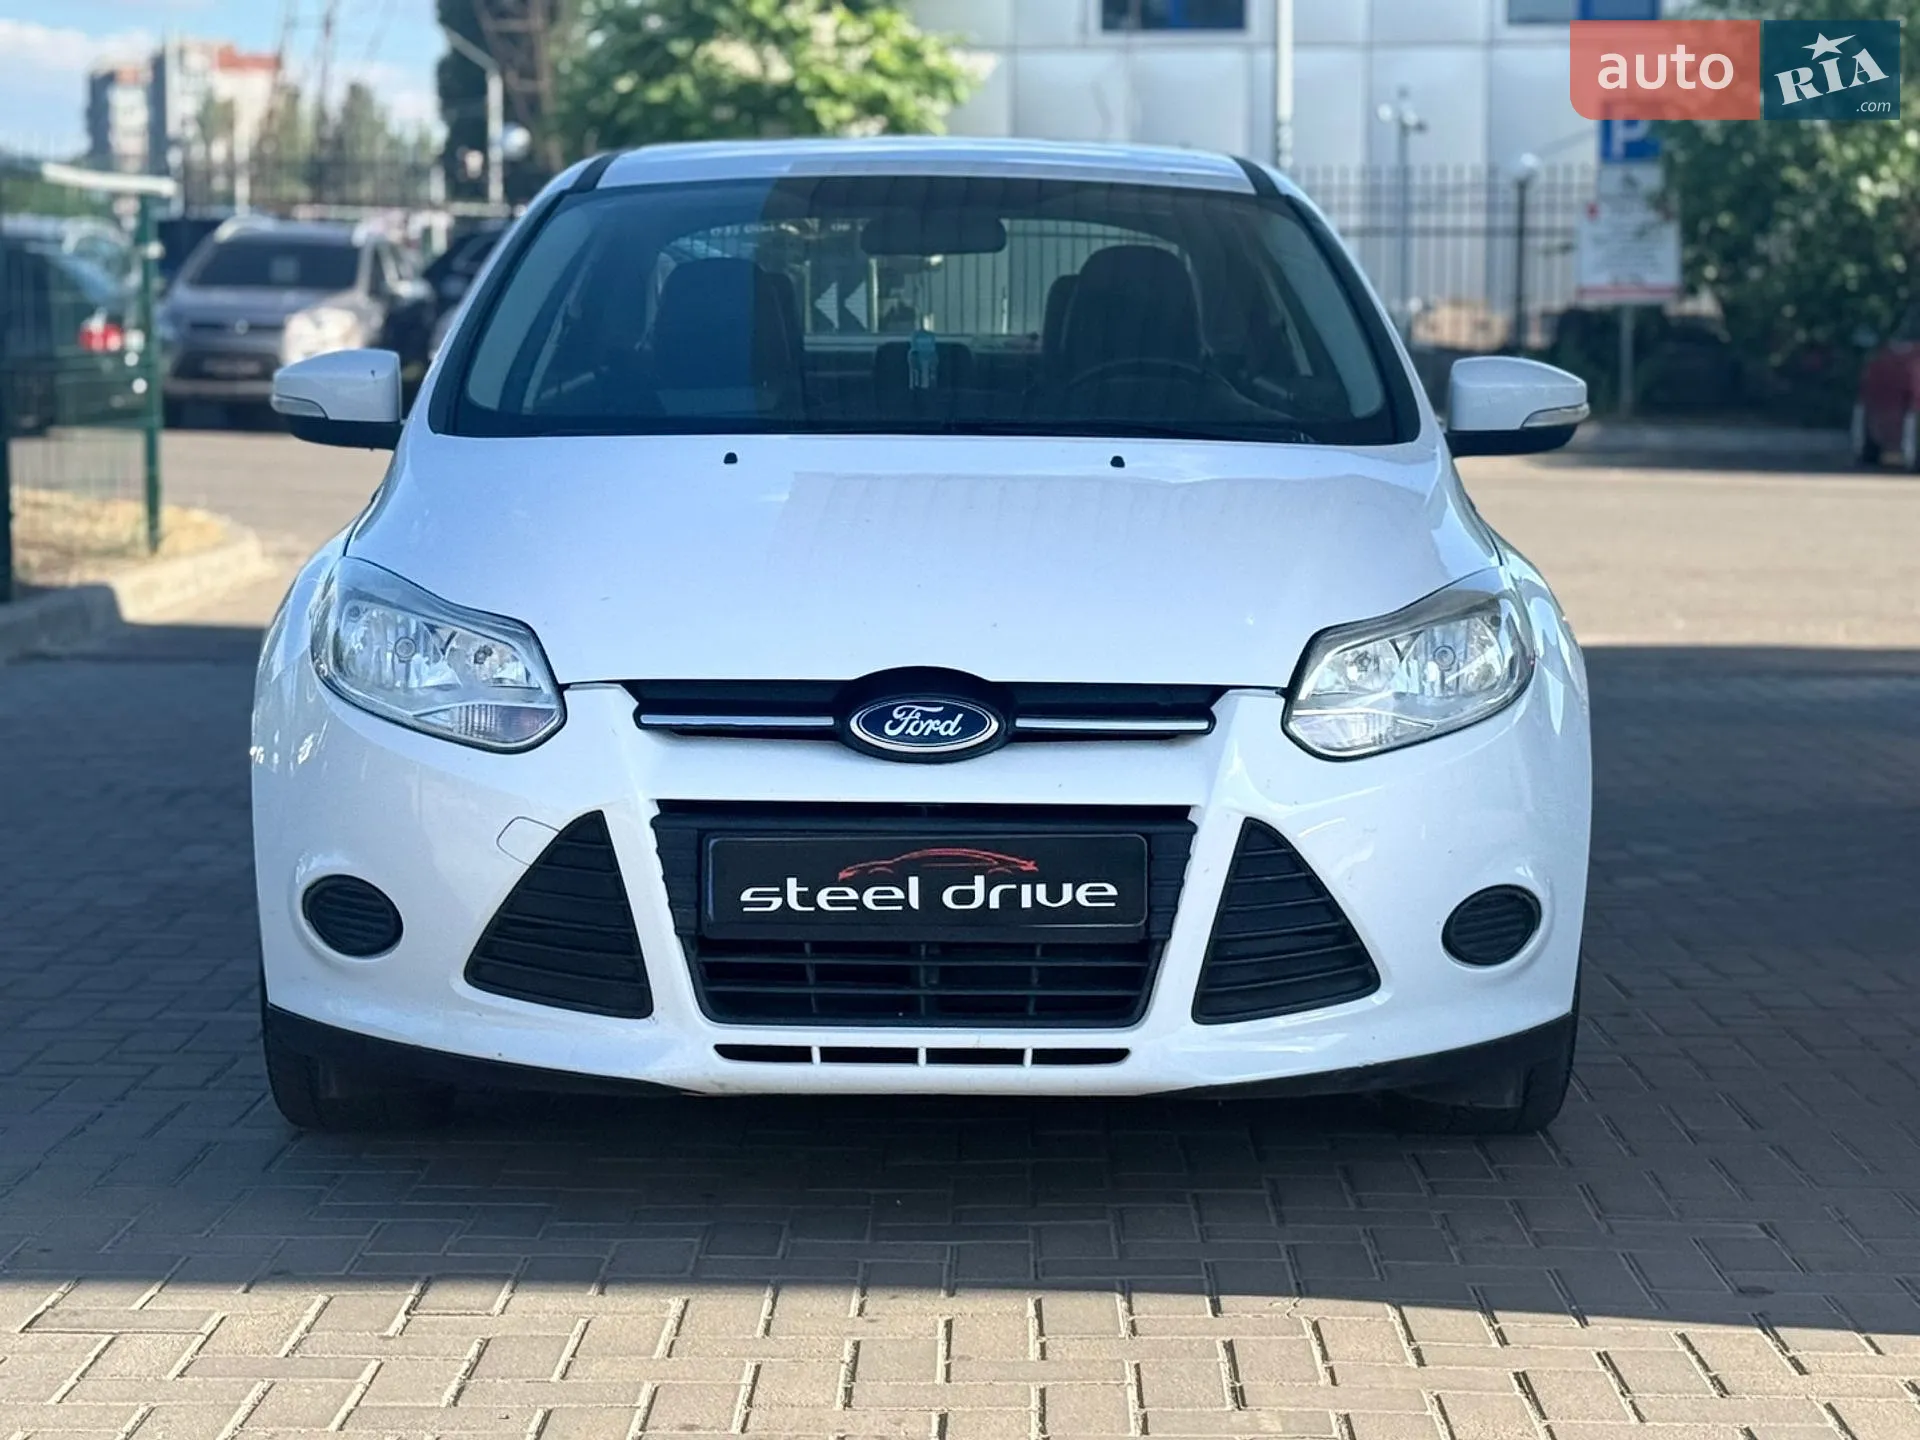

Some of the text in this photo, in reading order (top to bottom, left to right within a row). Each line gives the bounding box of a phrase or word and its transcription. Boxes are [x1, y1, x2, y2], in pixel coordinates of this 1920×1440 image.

[884, 704, 963, 738] Ford
[740, 874, 1118, 912] steel drive
